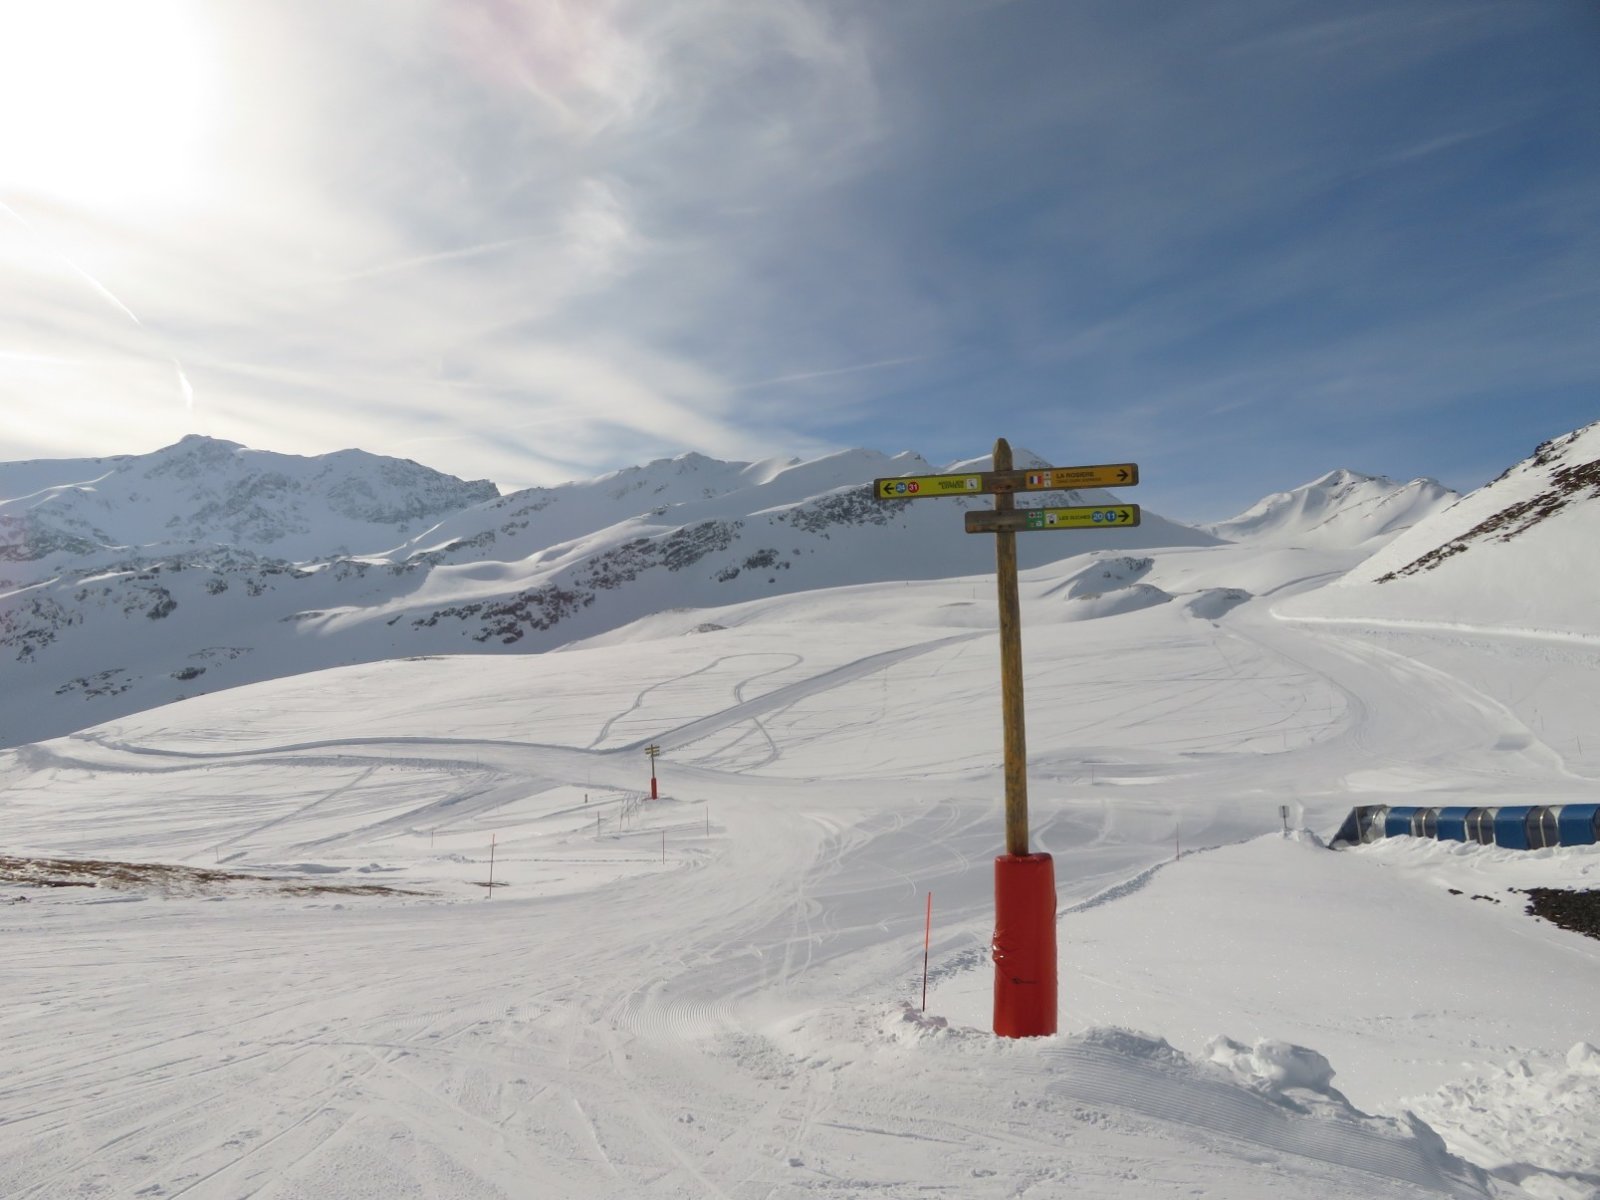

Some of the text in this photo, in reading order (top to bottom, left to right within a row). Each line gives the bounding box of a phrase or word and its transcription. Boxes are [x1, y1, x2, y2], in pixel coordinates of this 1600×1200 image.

[908, 483, 917, 491] 31
[1093, 512, 1115, 520] 20 11
